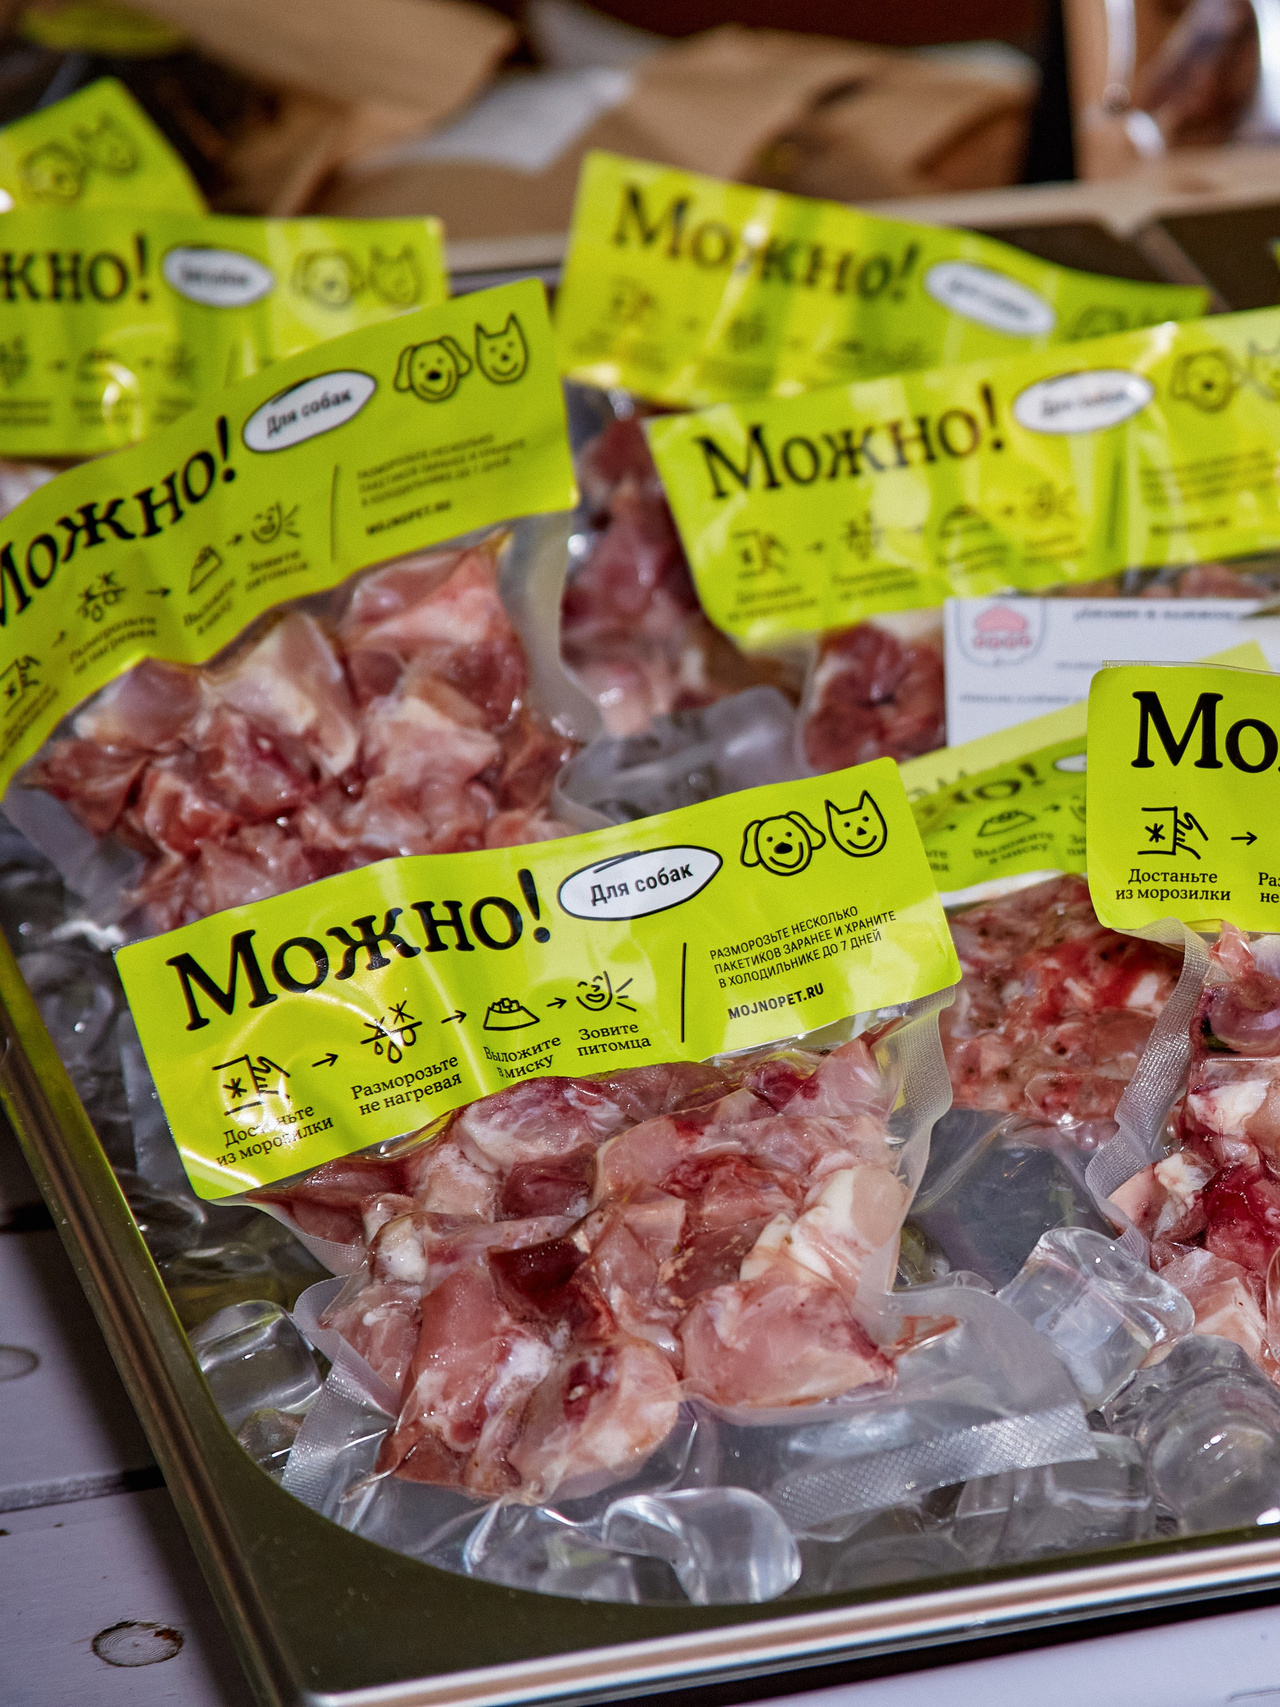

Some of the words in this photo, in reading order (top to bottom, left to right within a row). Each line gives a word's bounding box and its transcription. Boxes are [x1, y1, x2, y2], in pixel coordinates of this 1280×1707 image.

[266, 414, 297, 439] Для
[301, 386, 353, 420] собак
[695, 383, 1004, 499] Можно!
[589, 880, 630, 907] Для
[634, 864, 694, 893] собак
[1115, 888, 1133, 901] из
[1136, 887, 1231, 903] морозилки
[1128, 868, 1218, 886] Достаньте
[1260, 890, 1280, 904] не
[165, 868, 551, 1031] Можно!
[710, 927, 790, 960] РАЗМОРОЗЬТЕ
[792, 906, 858, 935] НЕСКОЛЬКО
[713, 947, 782, 975] ПАКЕТИКОВ
[785, 929, 833, 955] ЗАРАНЕЕ
[834, 926, 843, 937] И
[844, 910, 896, 934] ХРАНИТЕ
[718, 978, 727, 989] В
[729, 951, 821, 986] ХОЛОДИЛЬНИКЕ
[823, 943, 839, 957] ДО
[841, 940, 848, 951] 7
[850, 929, 882, 950] ДНЕЙ
[727, 983, 825, 1020] MOJNOPET.RU
[483, 1036, 561, 1063] Выложите
[577, 1037, 652, 1057] питомца
[578, 1023, 639, 1041] Зовите
[350, 1056, 459, 1100] Разморозьте
[496, 1066, 504, 1077] в
[505, 1054, 554, 1079] миску
[359, 1098, 381, 1116] не
[384, 1072, 462, 1111] нагревая
[223, 1106, 315, 1149] Досньте
[216, 1152, 237, 1166] из
